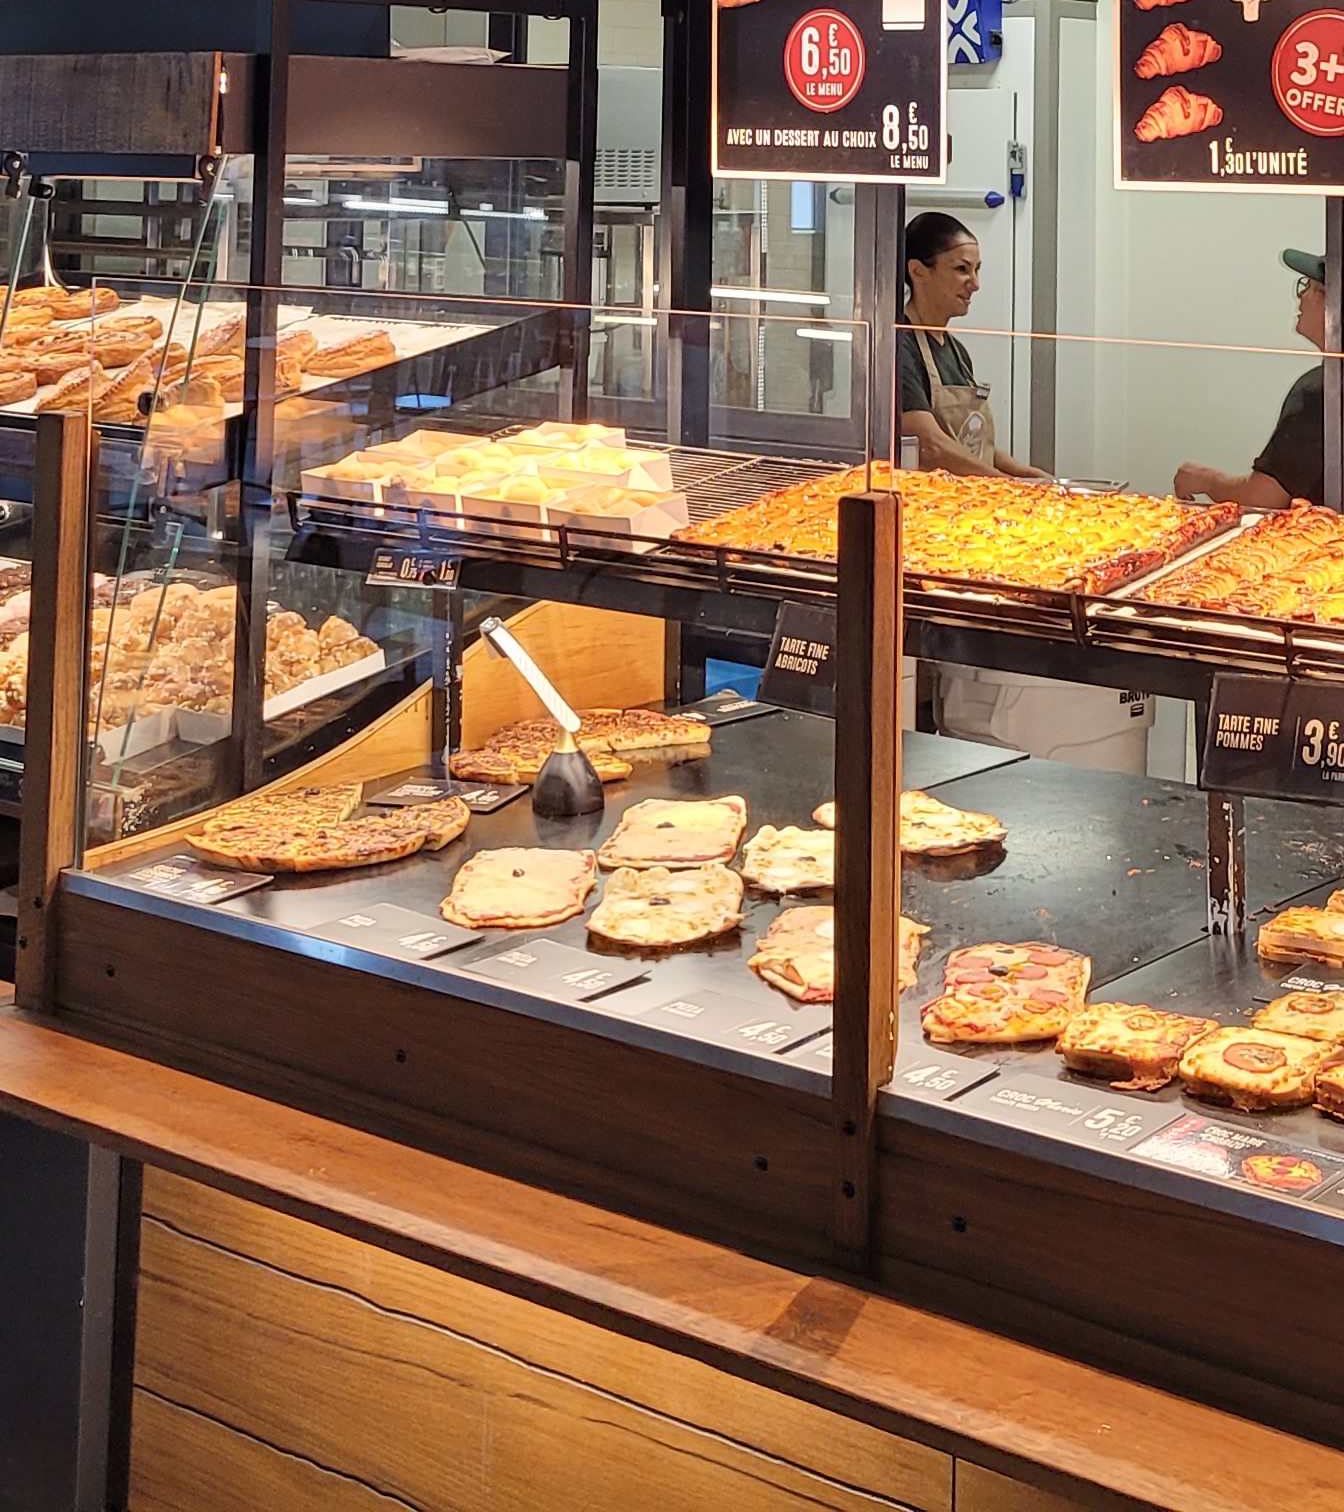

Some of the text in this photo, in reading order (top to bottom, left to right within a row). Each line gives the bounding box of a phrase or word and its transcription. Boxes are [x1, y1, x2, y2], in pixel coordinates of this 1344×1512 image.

[806, 83, 843, 96] LE MENU
[726, 128, 753, 146] AVEC
[756, 129, 771, 146] UN
[774, 129, 820, 148] DESSERT
[822, 131, 839, 148] AU
[842, 131, 877, 148] CHOIX
[890, 155, 929, 170] LE MENU
[780, 636, 830, 660] TARTE FINE
[775, 653, 818, 675] ABRICOTS
[1218, 714, 1251, 733] TARTE
[1254, 717, 1280, 735] FINE
[1216, 731, 1264, 751] POMMES
[1287, 976, 1324, 989] CROC
[997, 1089, 1036, 1105] CROC
